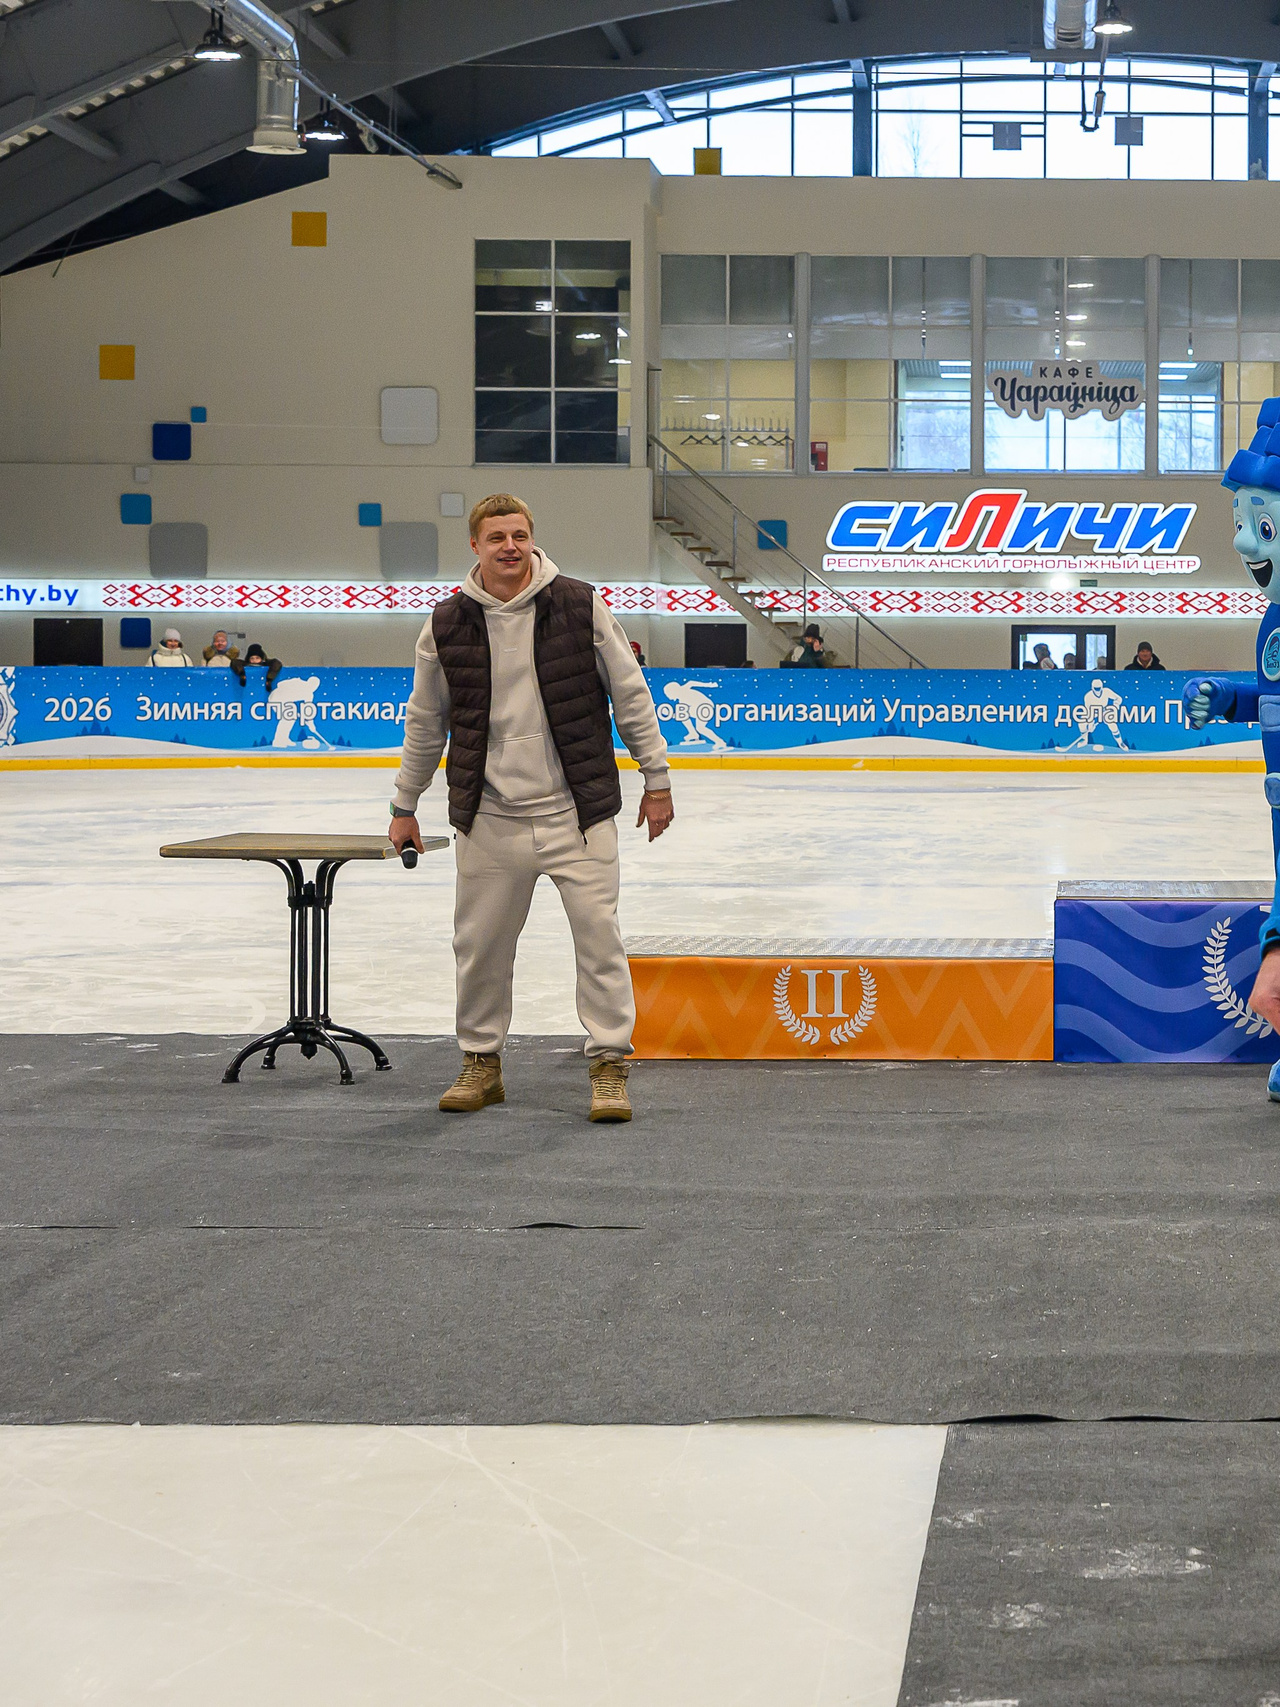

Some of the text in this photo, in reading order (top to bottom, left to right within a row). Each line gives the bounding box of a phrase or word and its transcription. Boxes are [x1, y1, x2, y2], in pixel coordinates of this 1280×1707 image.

[1040, 367, 1093, 378] КАФЕ
[994, 377, 1139, 414] Чараўніца
[827, 556, 1196, 571] РЕСПУБЛИКАНСКИЙ ГОРНОЛЫЖНЫЙ ЦЕНТР
[44, 697, 112, 722] 2026
[136, 696, 243, 722] Зимняя
[654, 703, 690, 722] ов
[697, 699, 876, 727] организаций
[884, 698, 1048, 728] Управления
[1054, 704, 1156, 727] делами
[800, 969, 850, 1018] II
